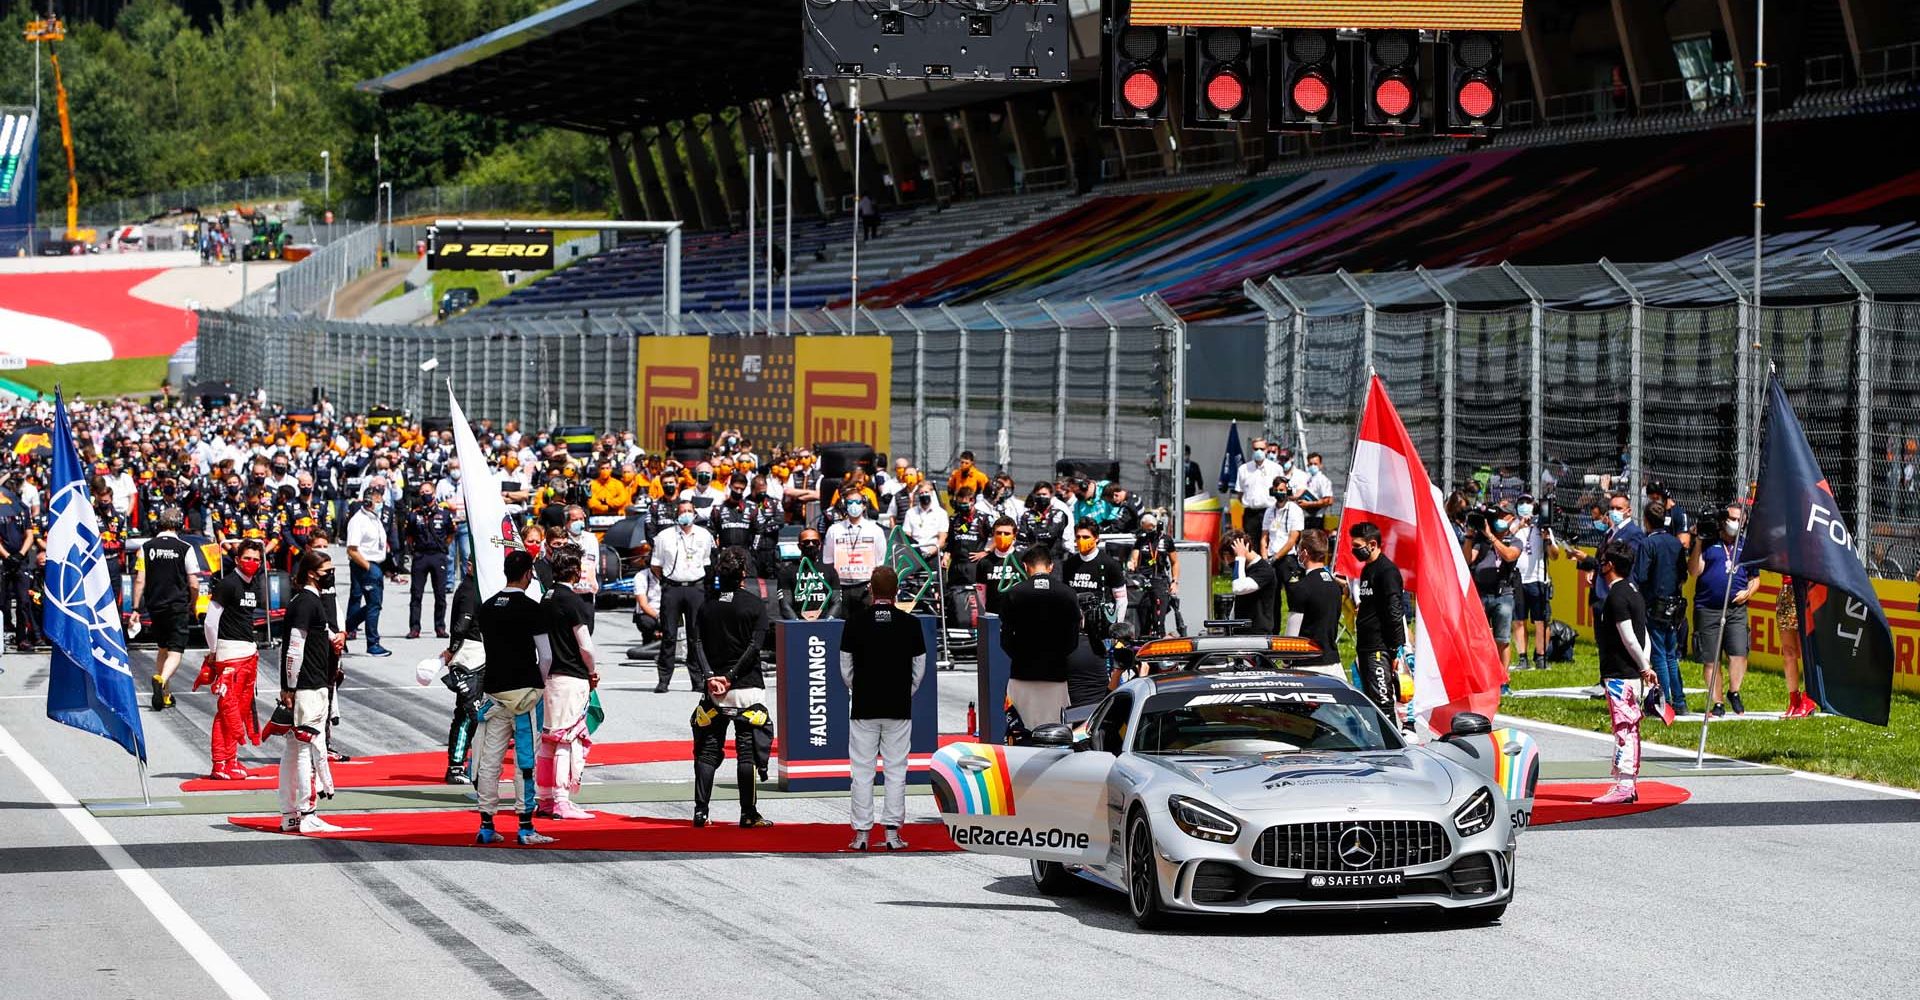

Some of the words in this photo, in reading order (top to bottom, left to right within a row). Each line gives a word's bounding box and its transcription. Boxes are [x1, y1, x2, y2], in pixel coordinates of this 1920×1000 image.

[441, 244, 462, 256] P
[466, 244, 549, 257] ZERO
[1159, 444, 1168, 463] F
[808, 635, 827, 747] #AUSTRIANGP
[1236, 692, 1337, 704] AMG
[1328, 875, 1374, 886] SAFETY
[1378, 874, 1401, 884] CAR
